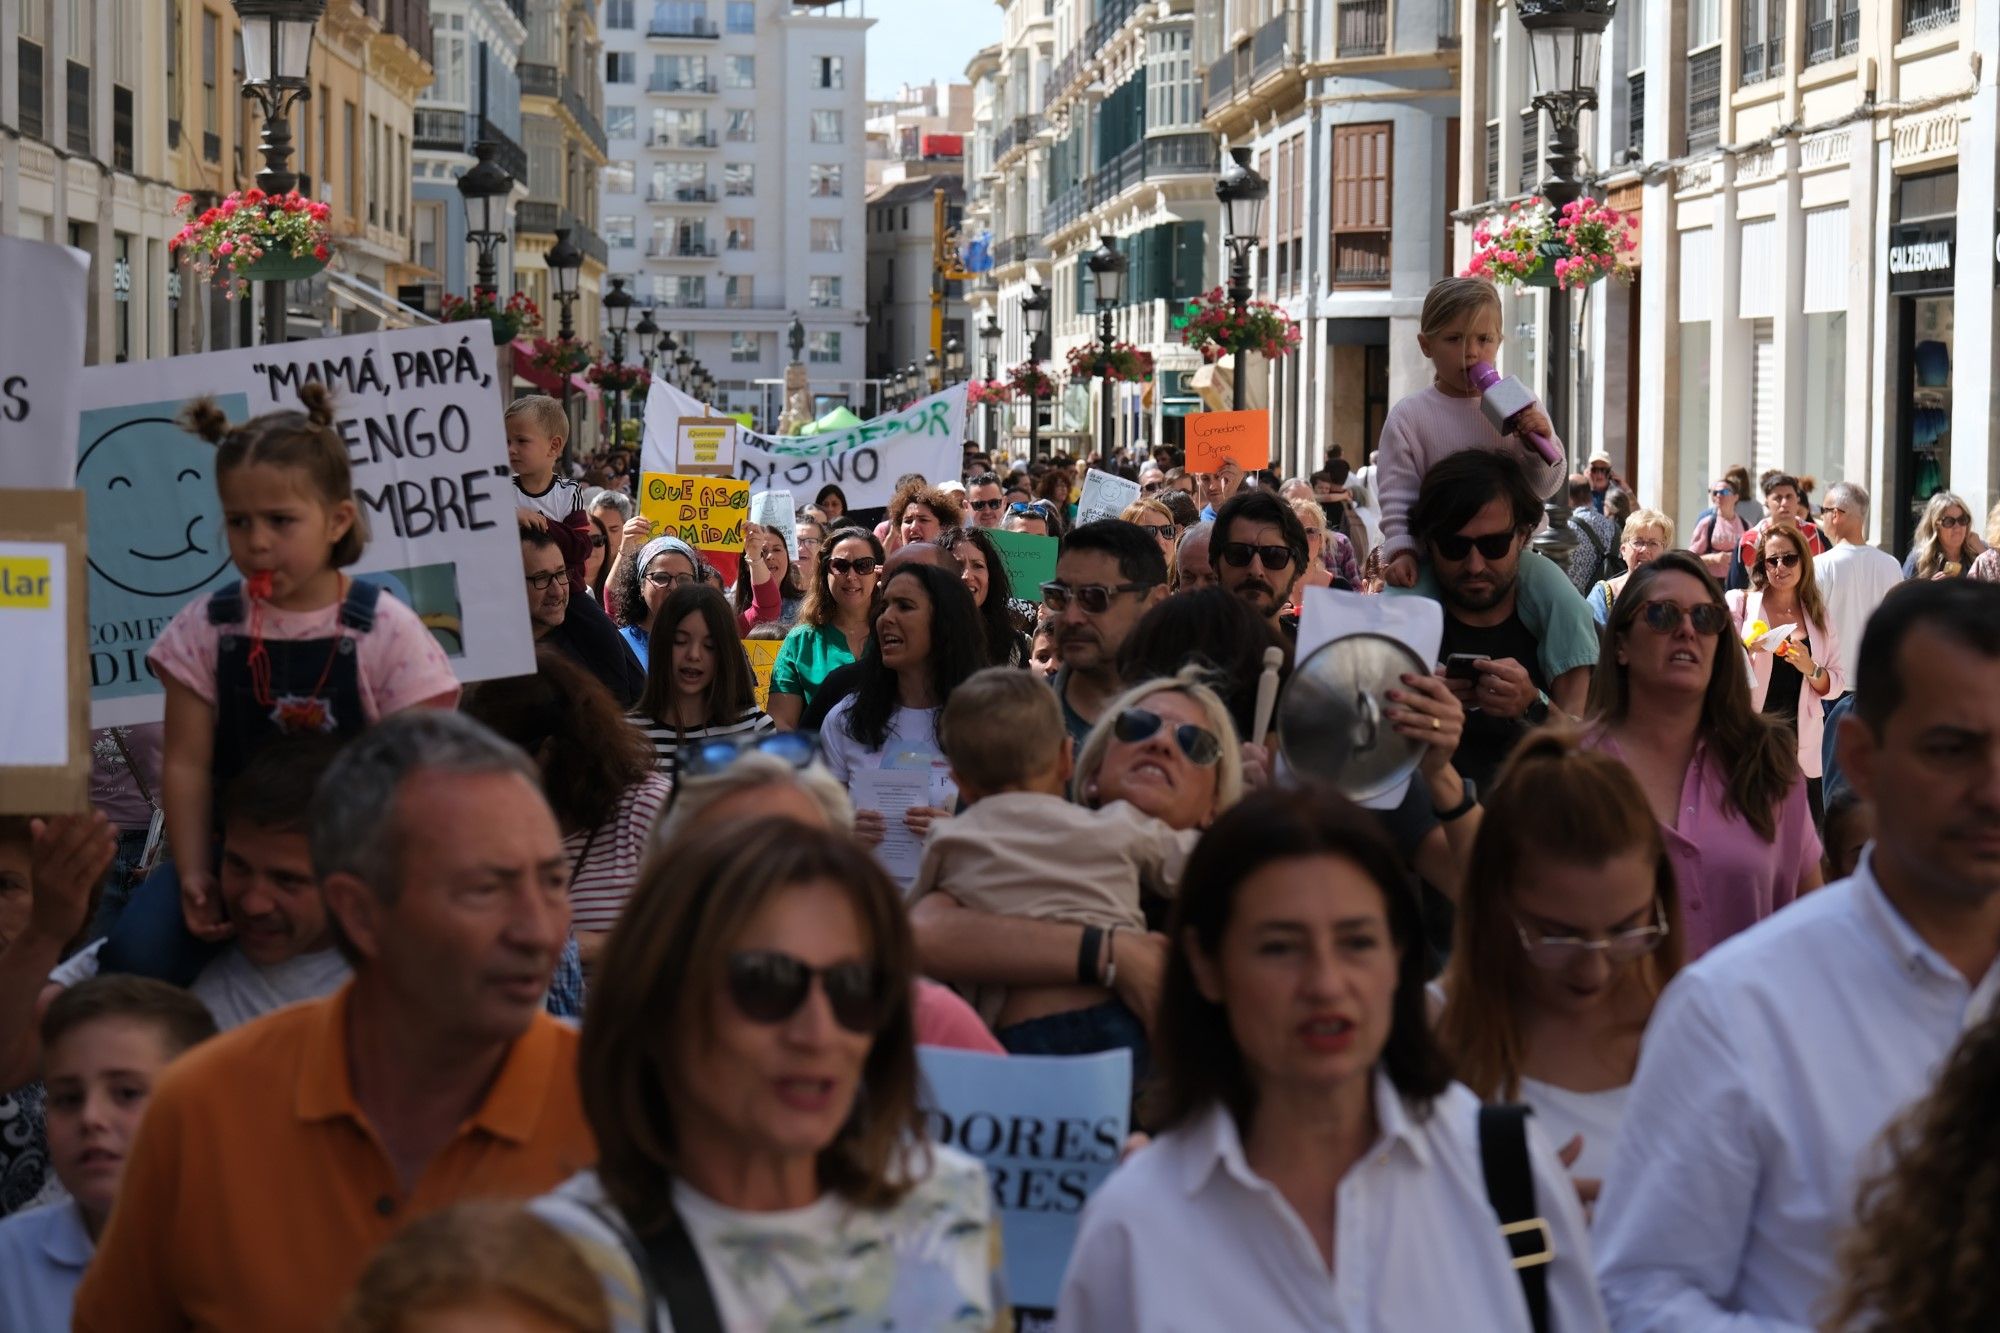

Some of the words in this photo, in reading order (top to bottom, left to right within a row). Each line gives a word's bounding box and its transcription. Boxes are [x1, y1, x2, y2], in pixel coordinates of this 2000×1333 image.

[1889, 241, 1950, 274] CALZEDONIA
[392, 336, 492, 389] PAPÁ,
[336, 403, 471, 467] ENGO
[354, 464, 511, 539] MBRE"
[679, 504, 709, 521] DE
[700, 486, 749, 509] ASCO
[1006, 543, 1041, 560] edores
[0, 569, 50, 597] lar
[90, 616, 173, 646] OME
